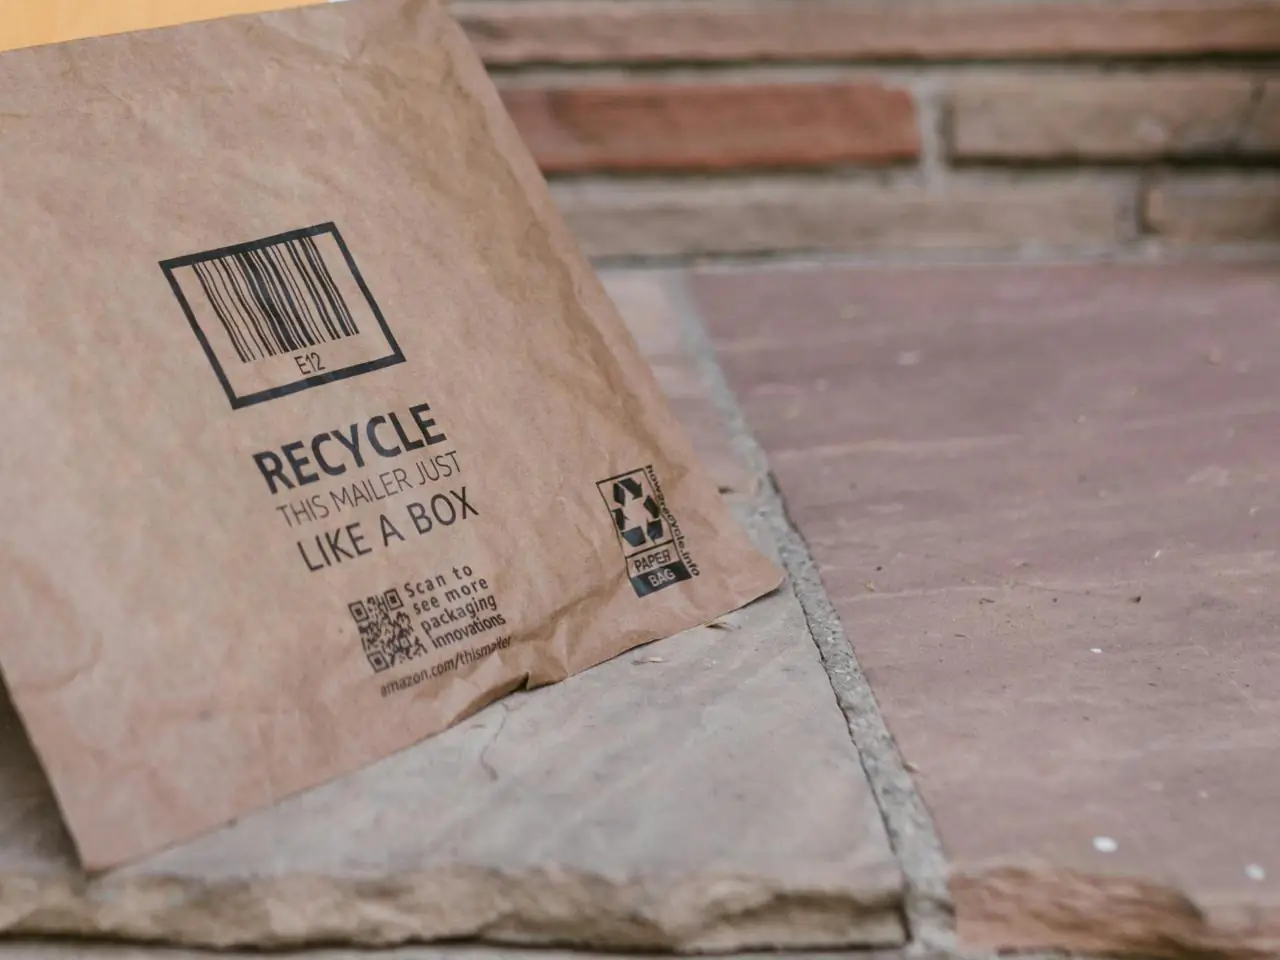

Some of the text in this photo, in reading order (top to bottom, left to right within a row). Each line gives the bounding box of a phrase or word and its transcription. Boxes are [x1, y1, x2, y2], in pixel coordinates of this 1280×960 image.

[294, 351, 325, 375] E12
[252, 403, 448, 495] RECYCLE
[276, 451, 463, 528] THIS MAILER JUST
[297, 486, 480, 573] LIKE A BOX
[634, 549, 671, 573] PAPER
[648, 568, 676, 587] BAG
[404, 564, 473, 598] Scan to
[413, 577, 489, 616] see more
[420, 594, 498, 637] packaging
[431, 612, 507, 649] innovations
